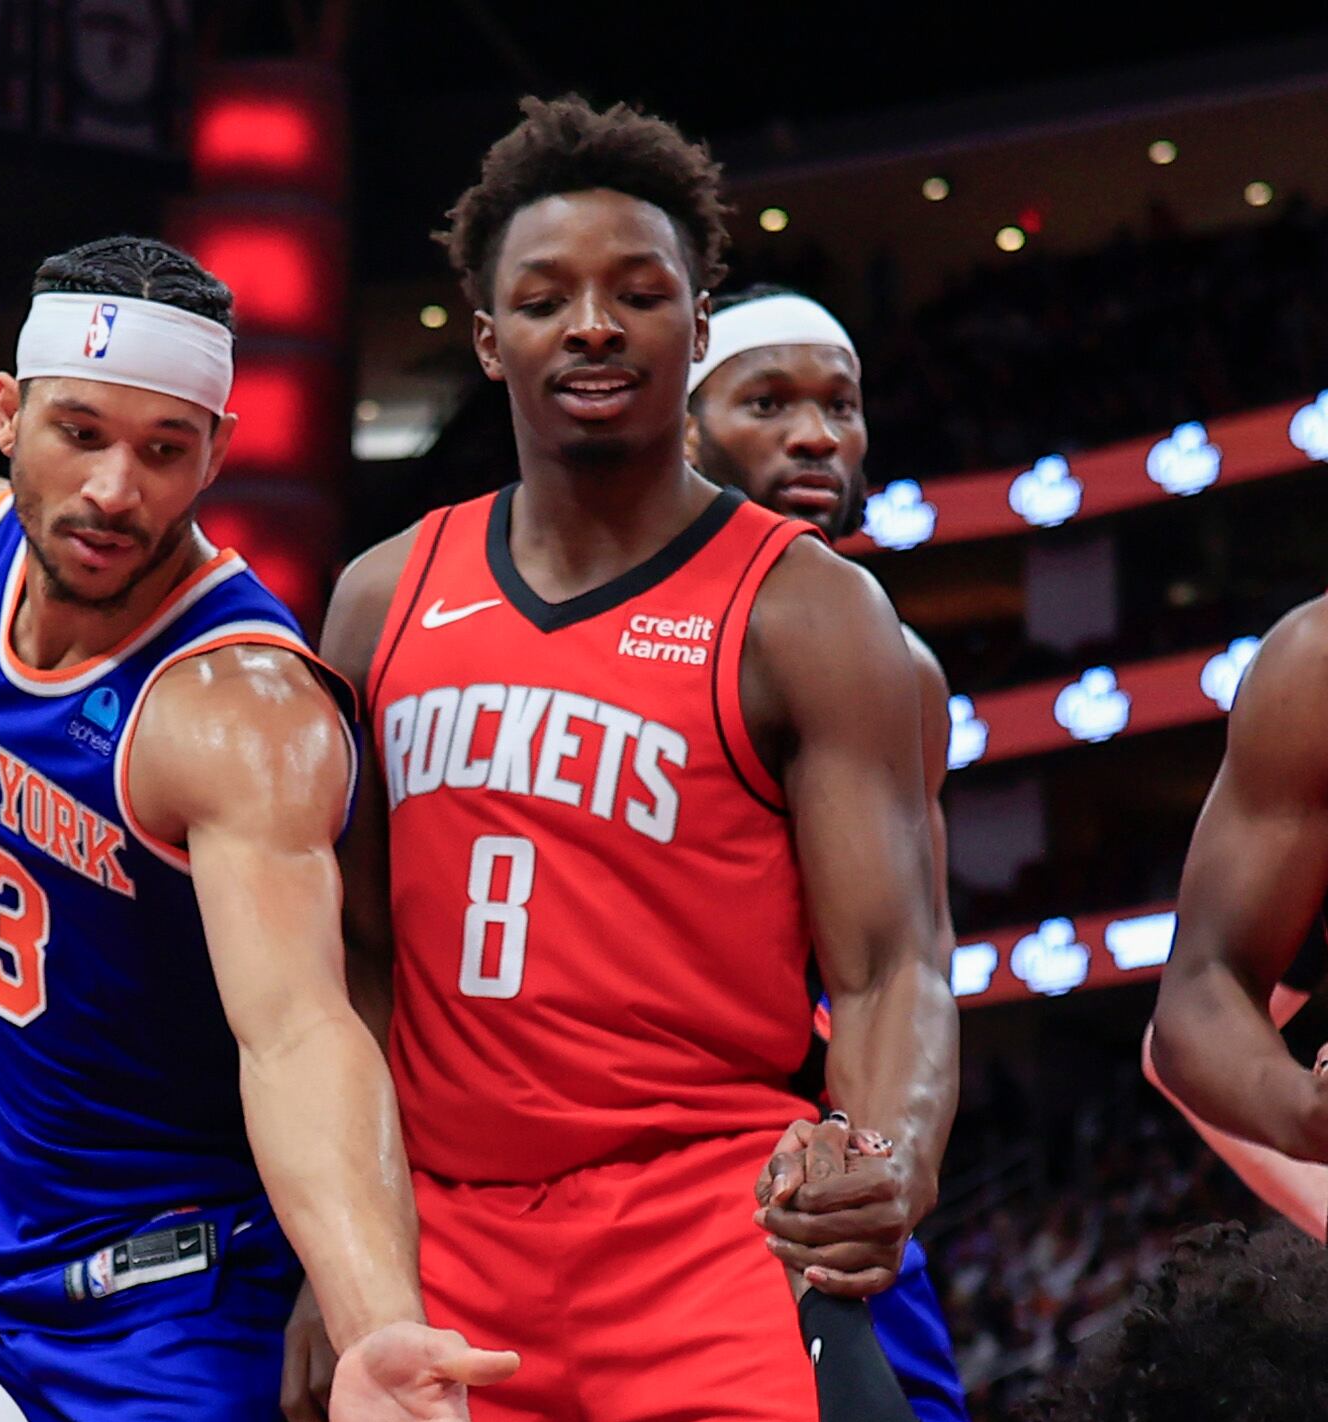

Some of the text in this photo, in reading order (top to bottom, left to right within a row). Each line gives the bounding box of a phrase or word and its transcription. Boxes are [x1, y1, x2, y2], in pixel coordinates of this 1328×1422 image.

[630, 614, 714, 641] credit
[618, 630, 707, 665] karma
[68, 719, 112, 756] sphere
[384, 683, 689, 845] ROCKETS
[459, 834, 536, 999] 8
